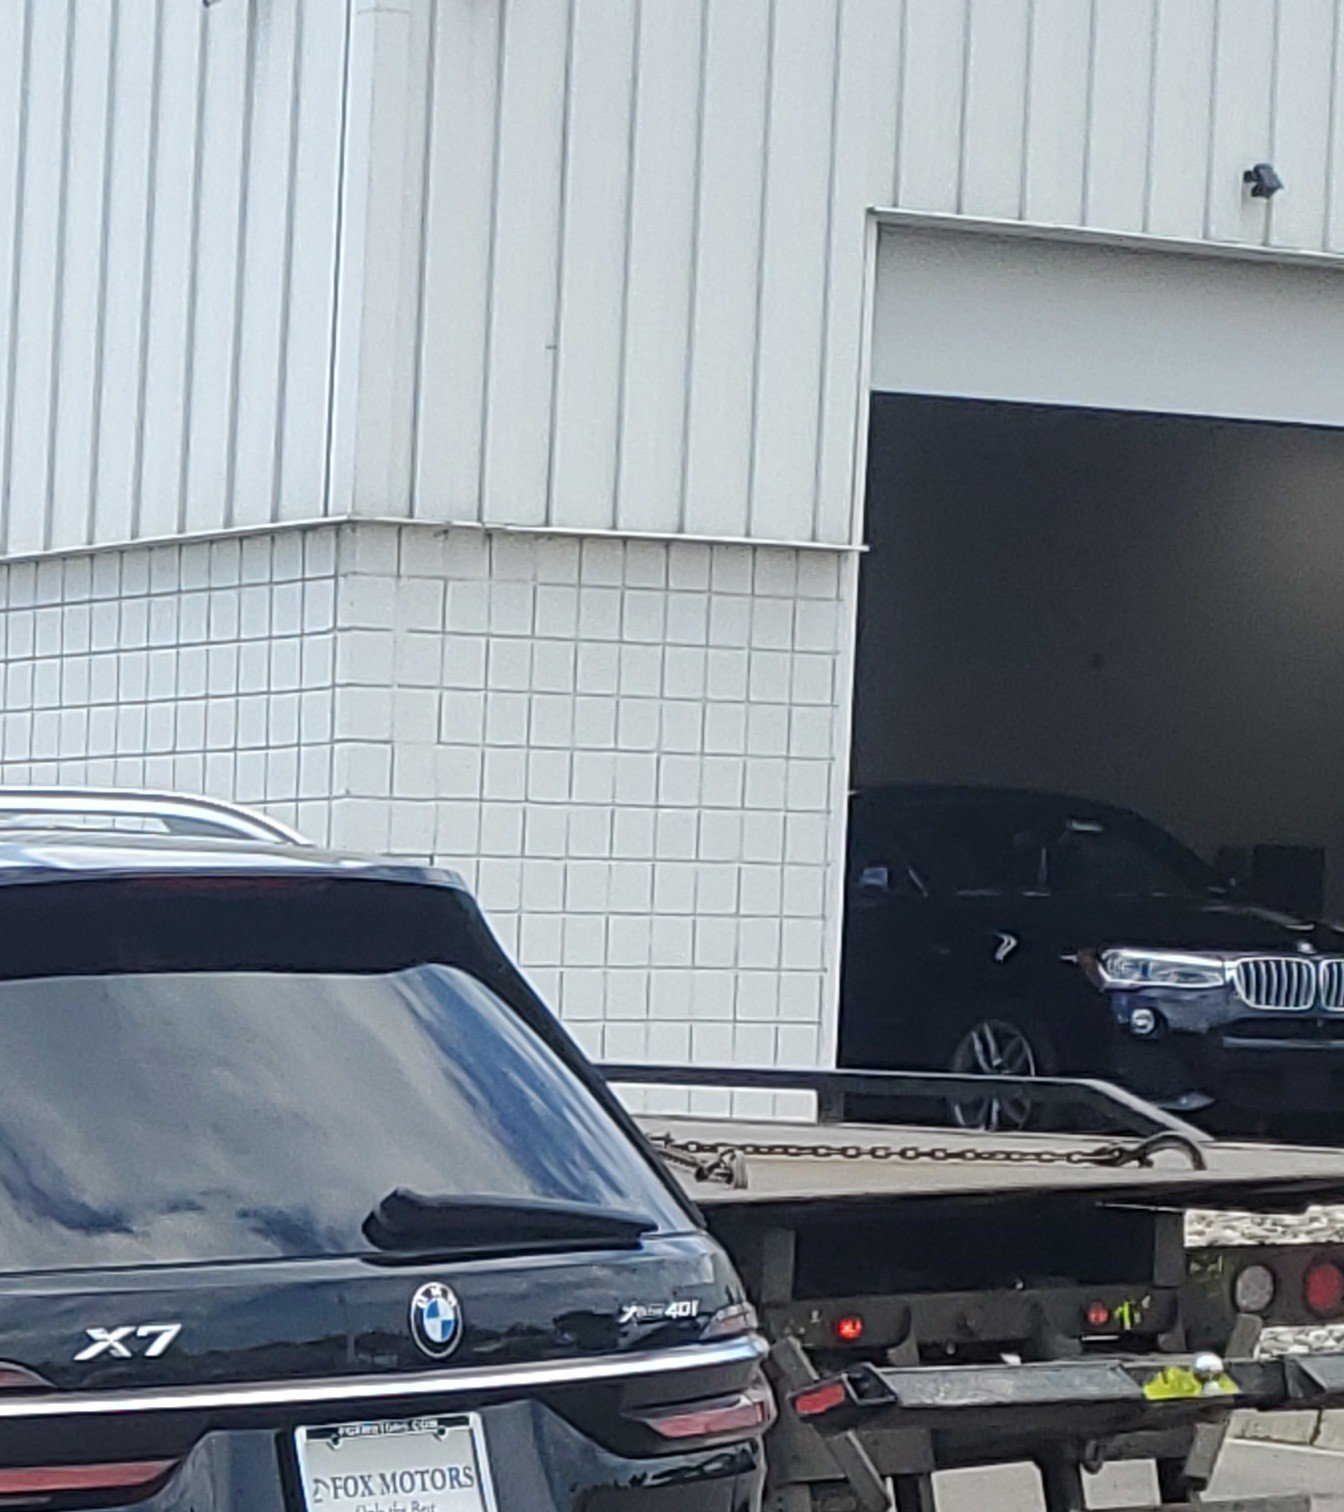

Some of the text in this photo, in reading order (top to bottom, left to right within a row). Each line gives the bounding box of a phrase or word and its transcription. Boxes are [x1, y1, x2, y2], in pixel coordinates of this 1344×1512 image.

[73, 1323, 182, 1361] X7
[329, 1466, 475, 1499] FOX MOTORS
